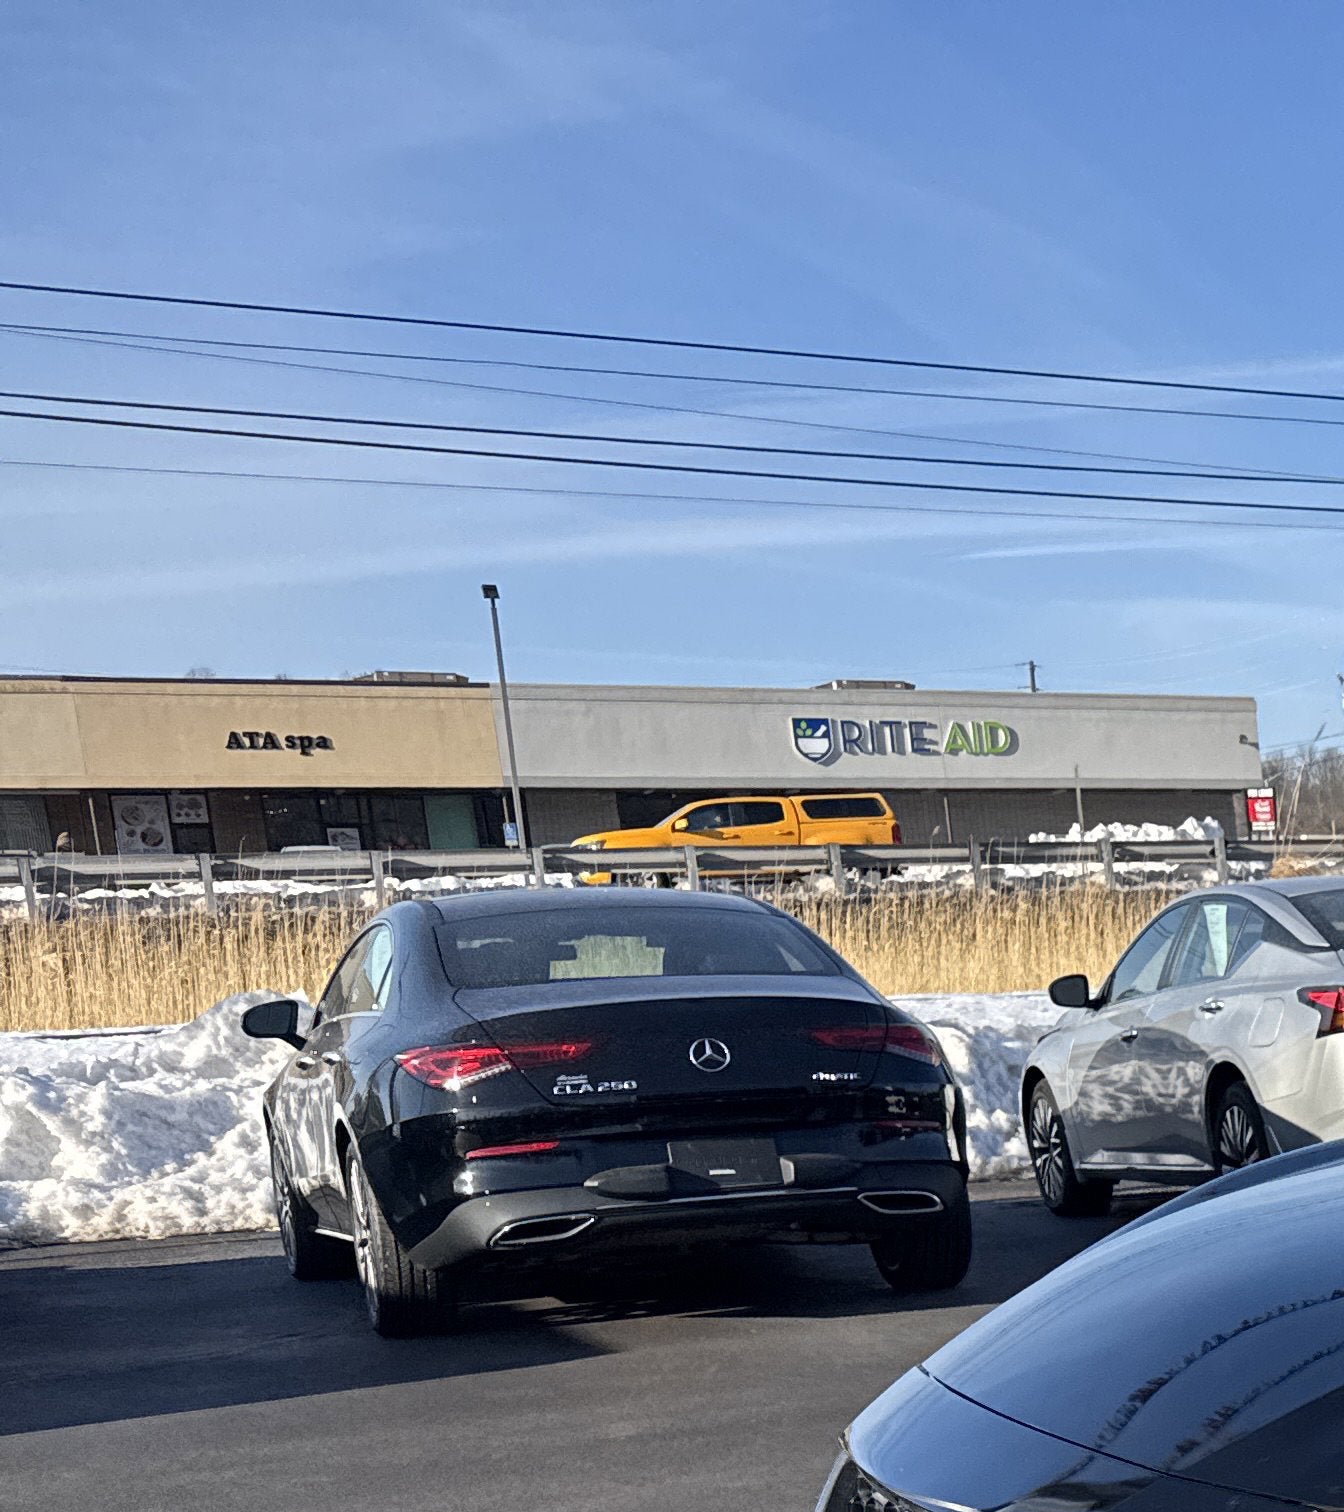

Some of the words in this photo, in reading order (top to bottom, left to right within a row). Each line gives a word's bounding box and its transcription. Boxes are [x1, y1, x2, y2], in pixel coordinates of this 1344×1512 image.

[225, 731, 284, 750] ATA
[284, 734, 335, 757] spa
[840, 719, 938, 754] RITE
[943, 719, 1012, 754] AID
[552, 1083, 595, 1095] CLA
[597, 1080, 638, 1093] 250
